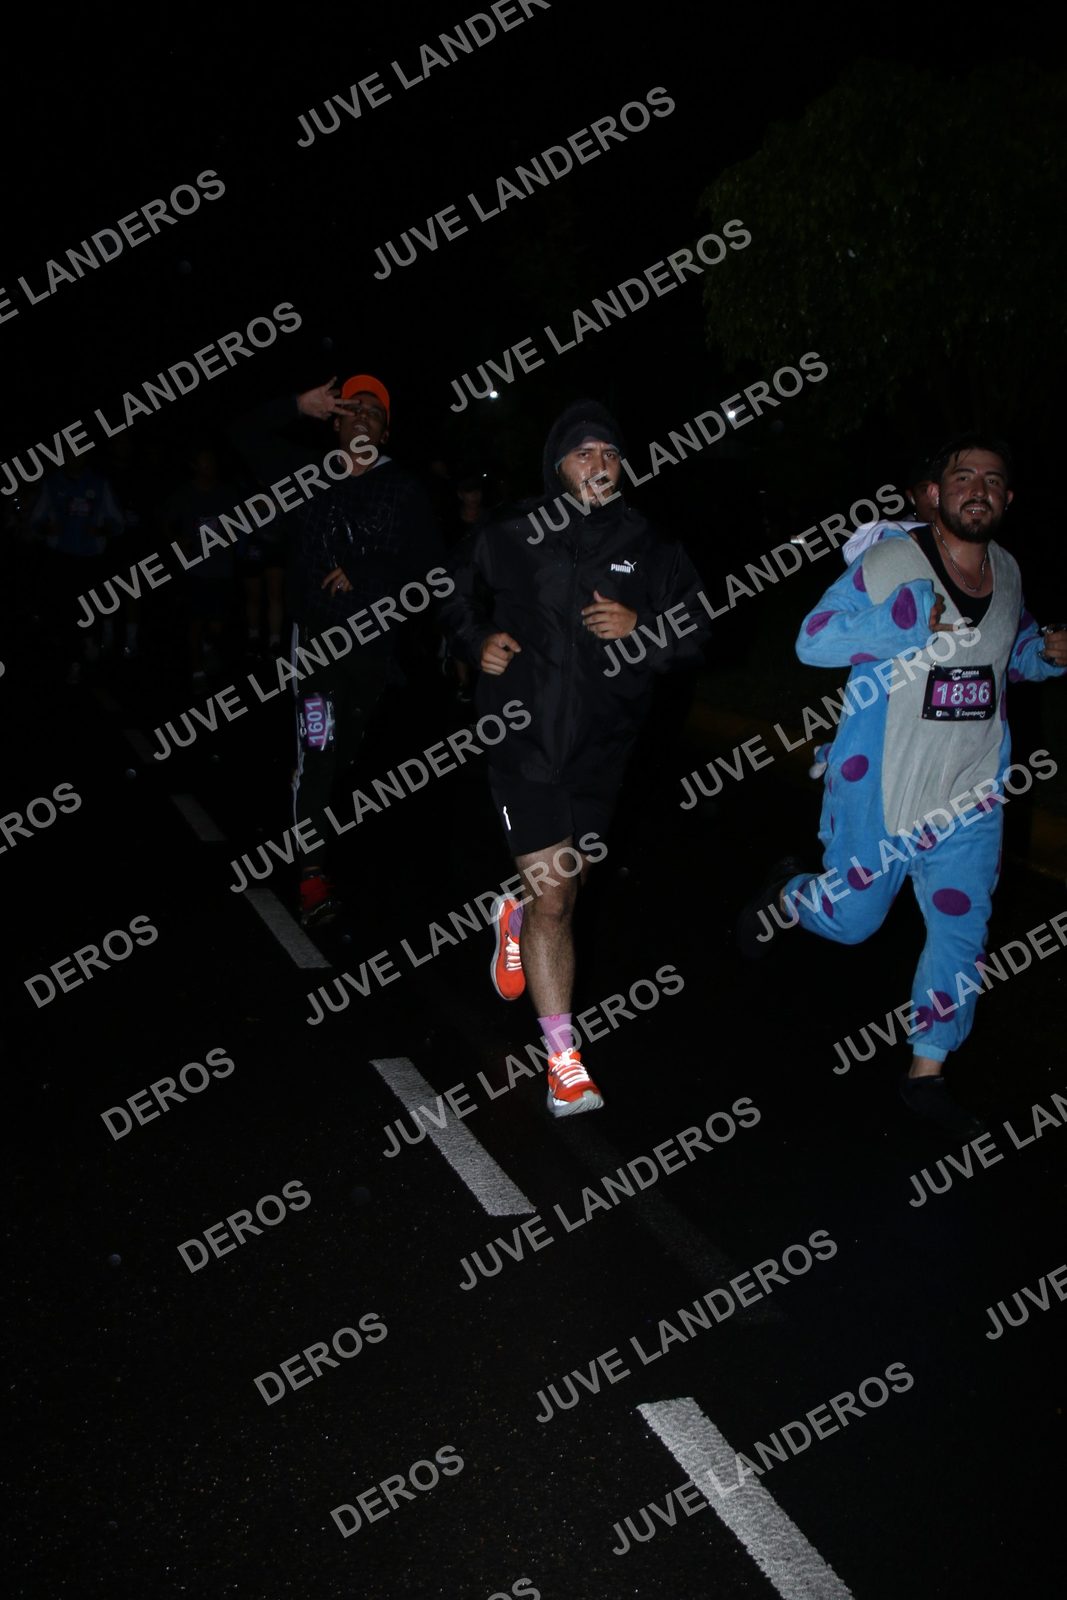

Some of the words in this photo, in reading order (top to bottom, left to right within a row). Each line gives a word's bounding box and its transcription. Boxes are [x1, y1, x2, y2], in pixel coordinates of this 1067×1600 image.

[610, 563, 631, 574] PUMA
[937, 681, 990, 705] 1836
[305, 701, 324, 744] 1601
